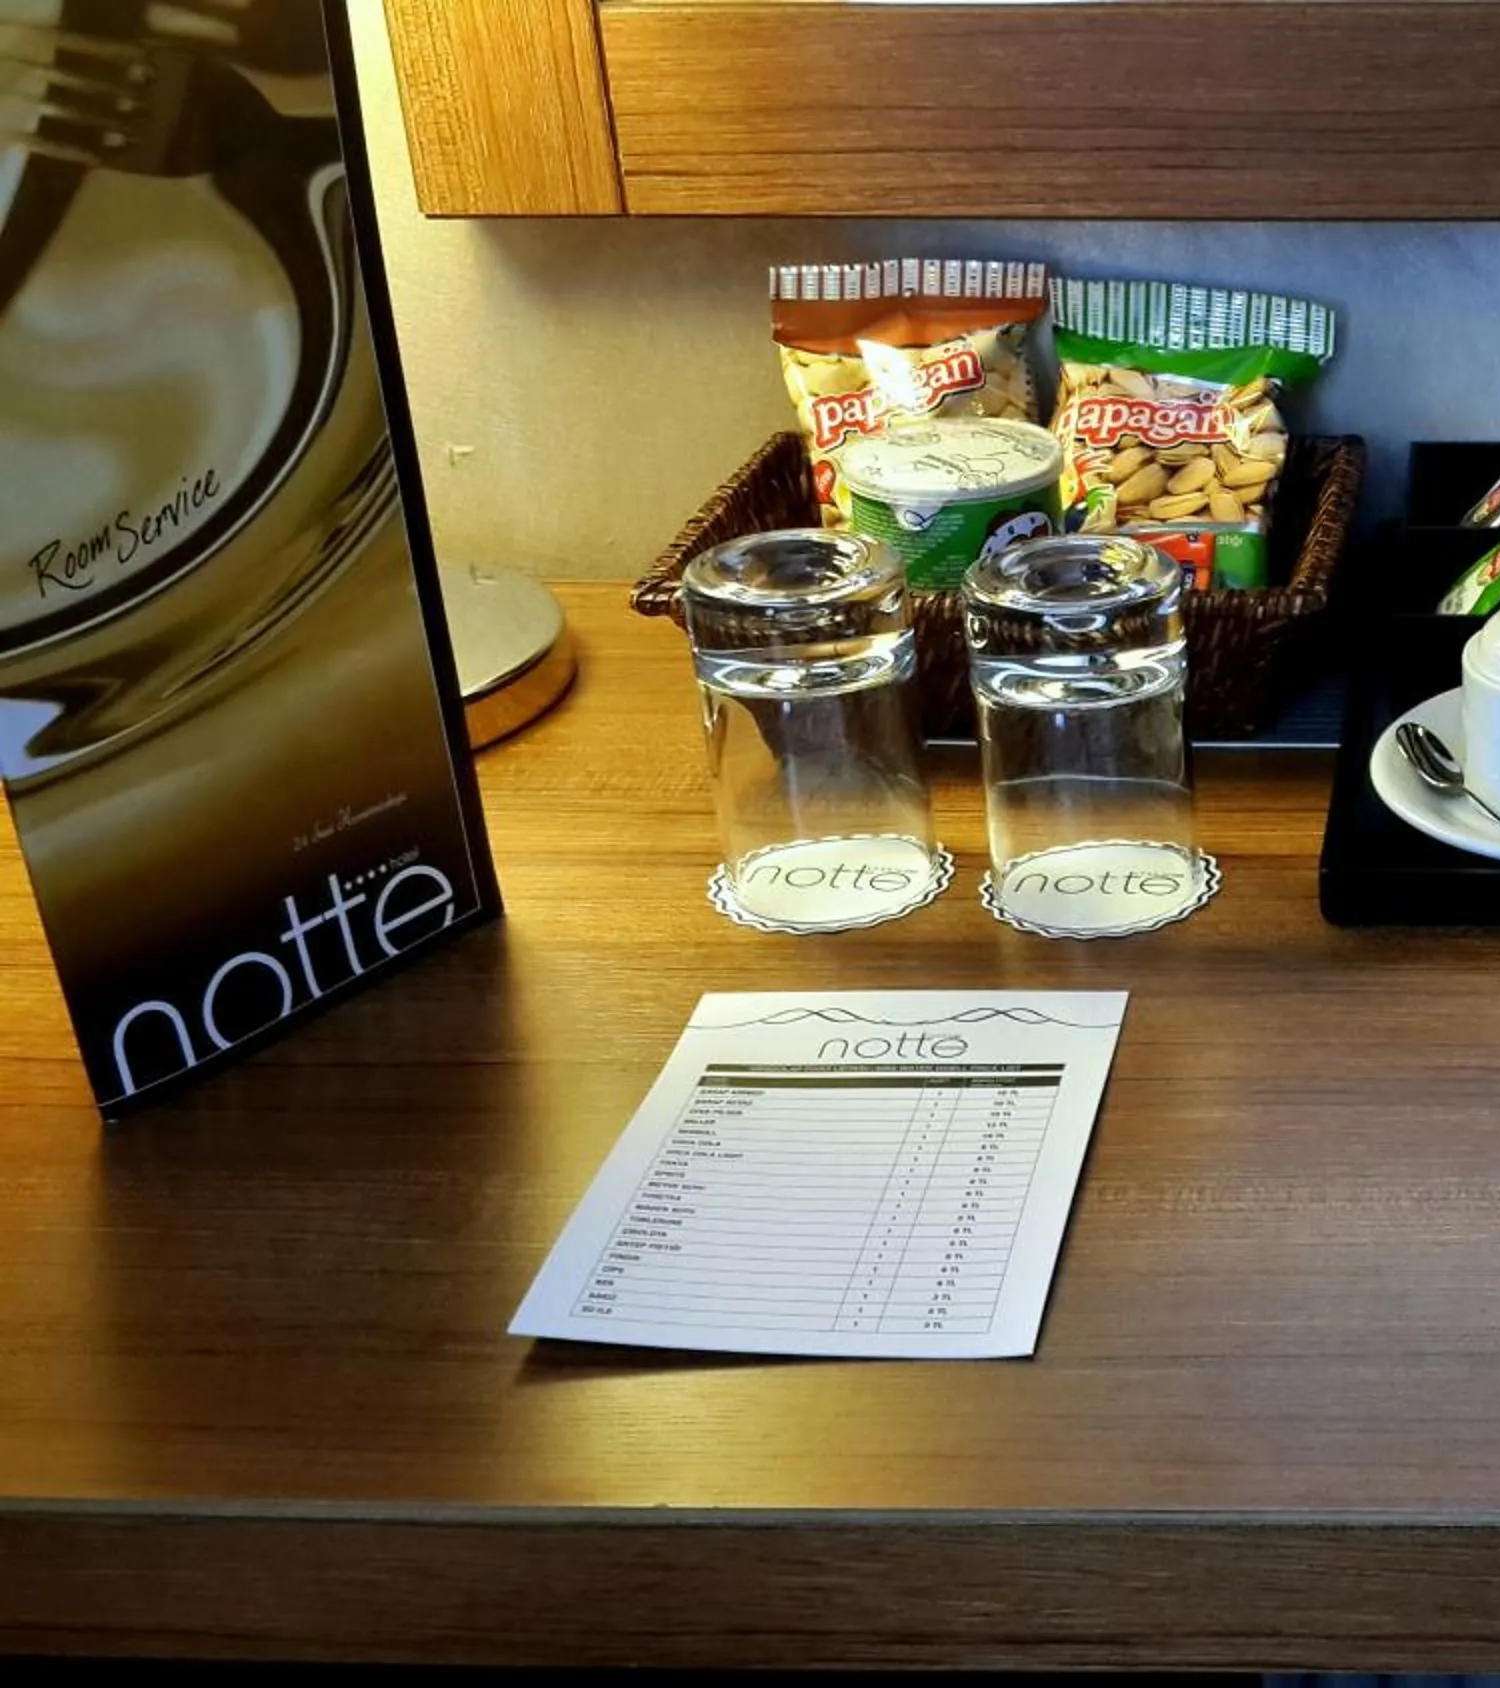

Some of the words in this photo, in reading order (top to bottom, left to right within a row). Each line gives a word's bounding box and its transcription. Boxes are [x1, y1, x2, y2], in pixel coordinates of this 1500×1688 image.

[815, 351, 977, 441] papgan
[746, 863, 911, 892] notte
[1014, 871, 1181, 896] notte
[111, 864, 455, 1098] notte
[817, 1032, 969, 1059] notte
